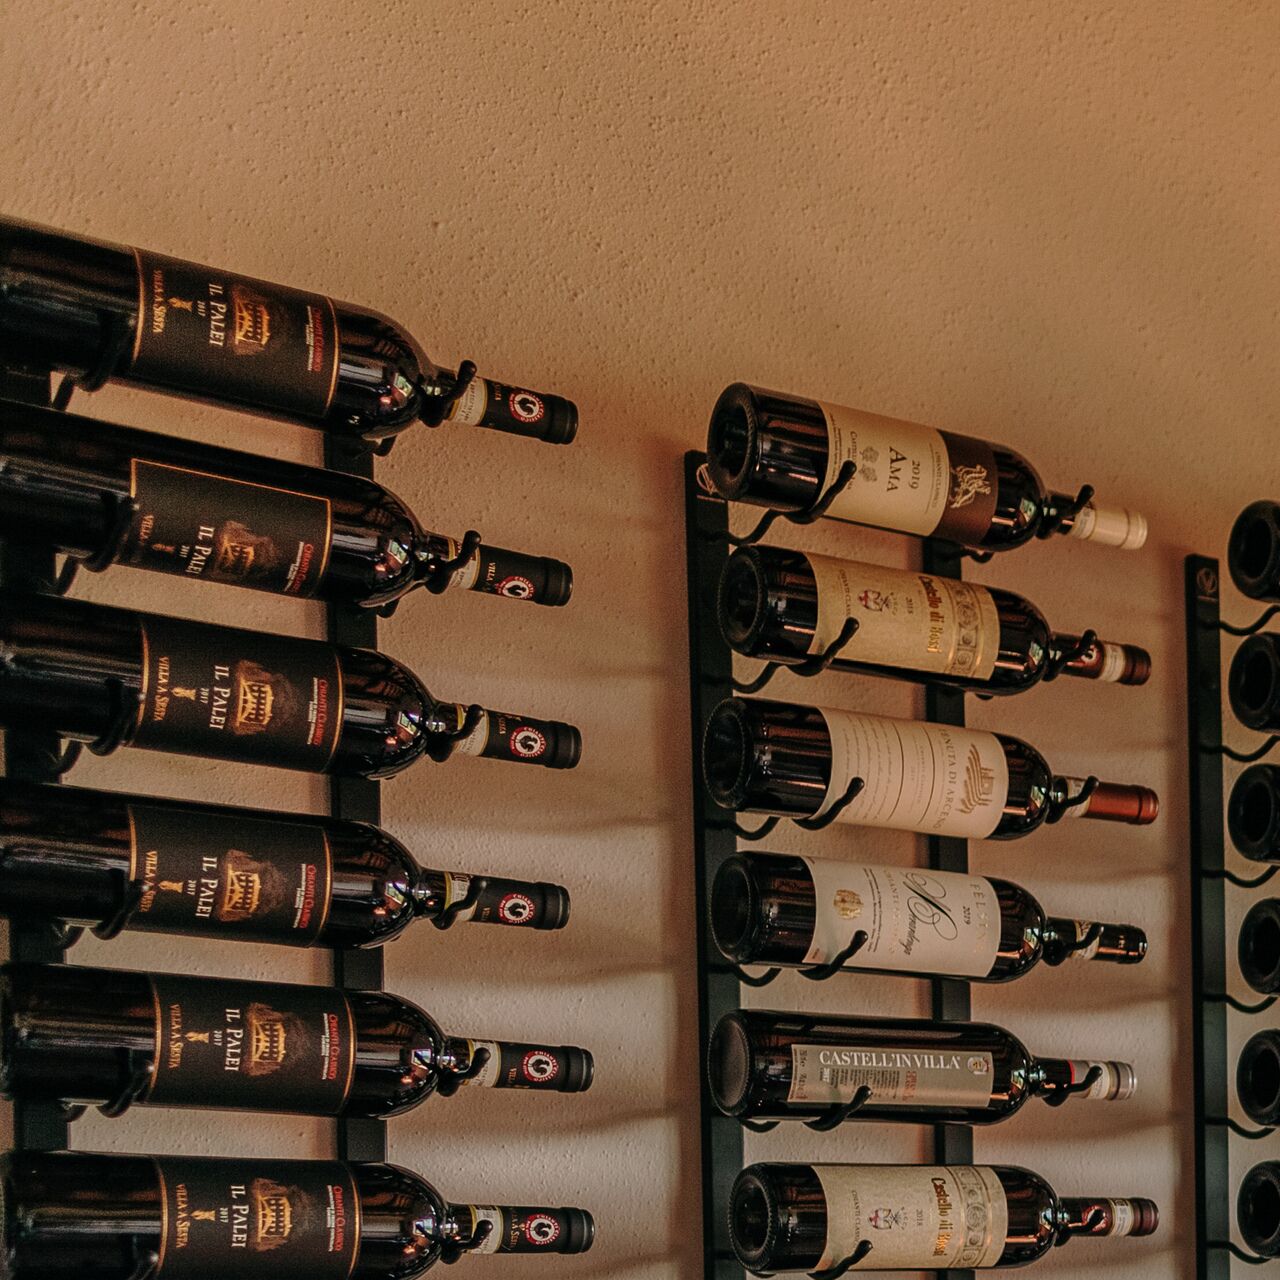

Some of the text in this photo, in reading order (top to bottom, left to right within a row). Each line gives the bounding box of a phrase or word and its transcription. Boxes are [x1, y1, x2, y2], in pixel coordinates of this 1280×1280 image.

[209, 283, 226, 346] IL PALEI
[887, 447, 908, 492] AMA
[908, 460, 921, 490] 2019
[198, 526, 214, 540] IL
[210, 665, 231, 730] IL PALEI
[948, 770, 957, 784] DI
[195, 856, 219, 918] IL PALEI
[224, 1008, 243, 1071] IL PALEI
[230, 1184, 249, 1248] IL PALEI
[931, 1178, 952, 1216] Castello
